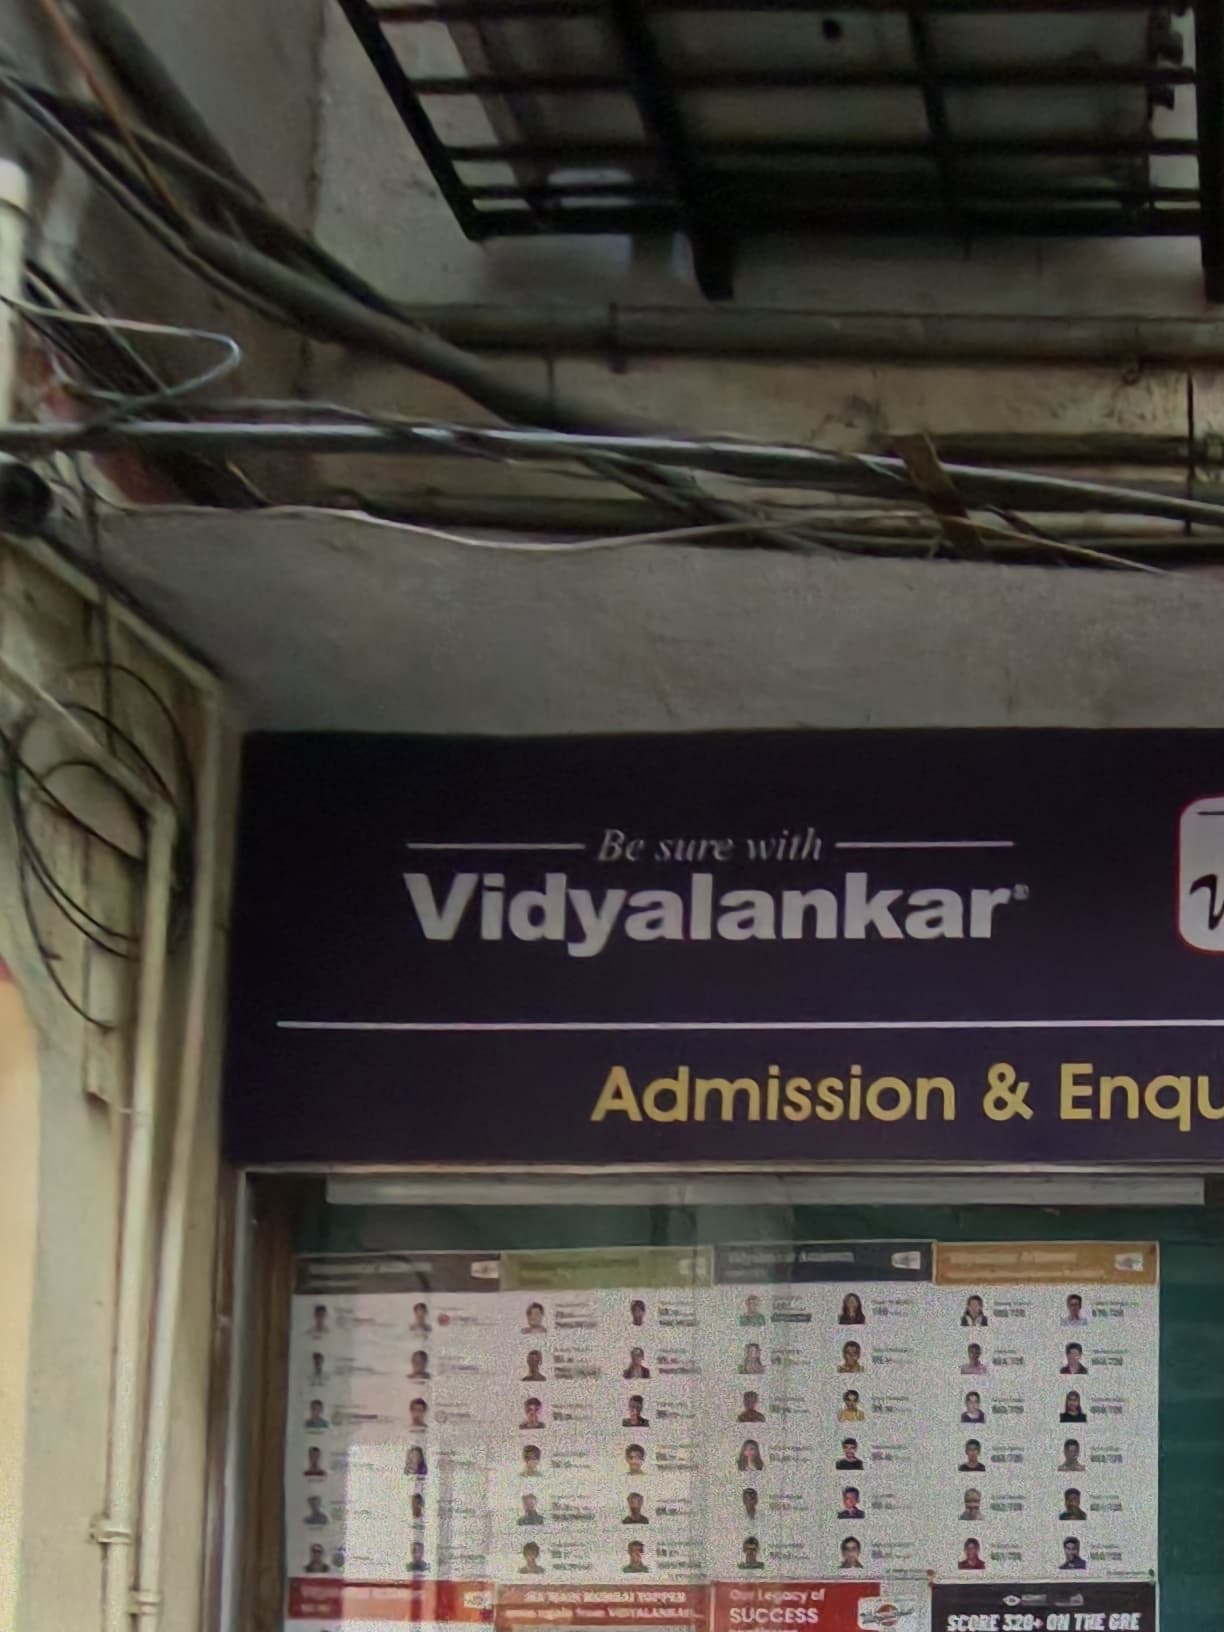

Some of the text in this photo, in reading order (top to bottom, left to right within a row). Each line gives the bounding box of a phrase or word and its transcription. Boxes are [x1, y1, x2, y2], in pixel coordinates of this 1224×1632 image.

[597, 828, 822, 861] Be sure with
[591, 1065, 956, 1122] Admission
[982, 1064, 1034, 1122] &
[758, 1589, 807, 1603] Legacy
[729, 1607, 819, 1624] SUCCESS
[947, 1614, 1000, 1632] SCORE
[1046, 1614, 1070, 1631] ON
[1074, 1613, 1106, 1631] THE
[1108, 1613, 1141, 1631] GRE
